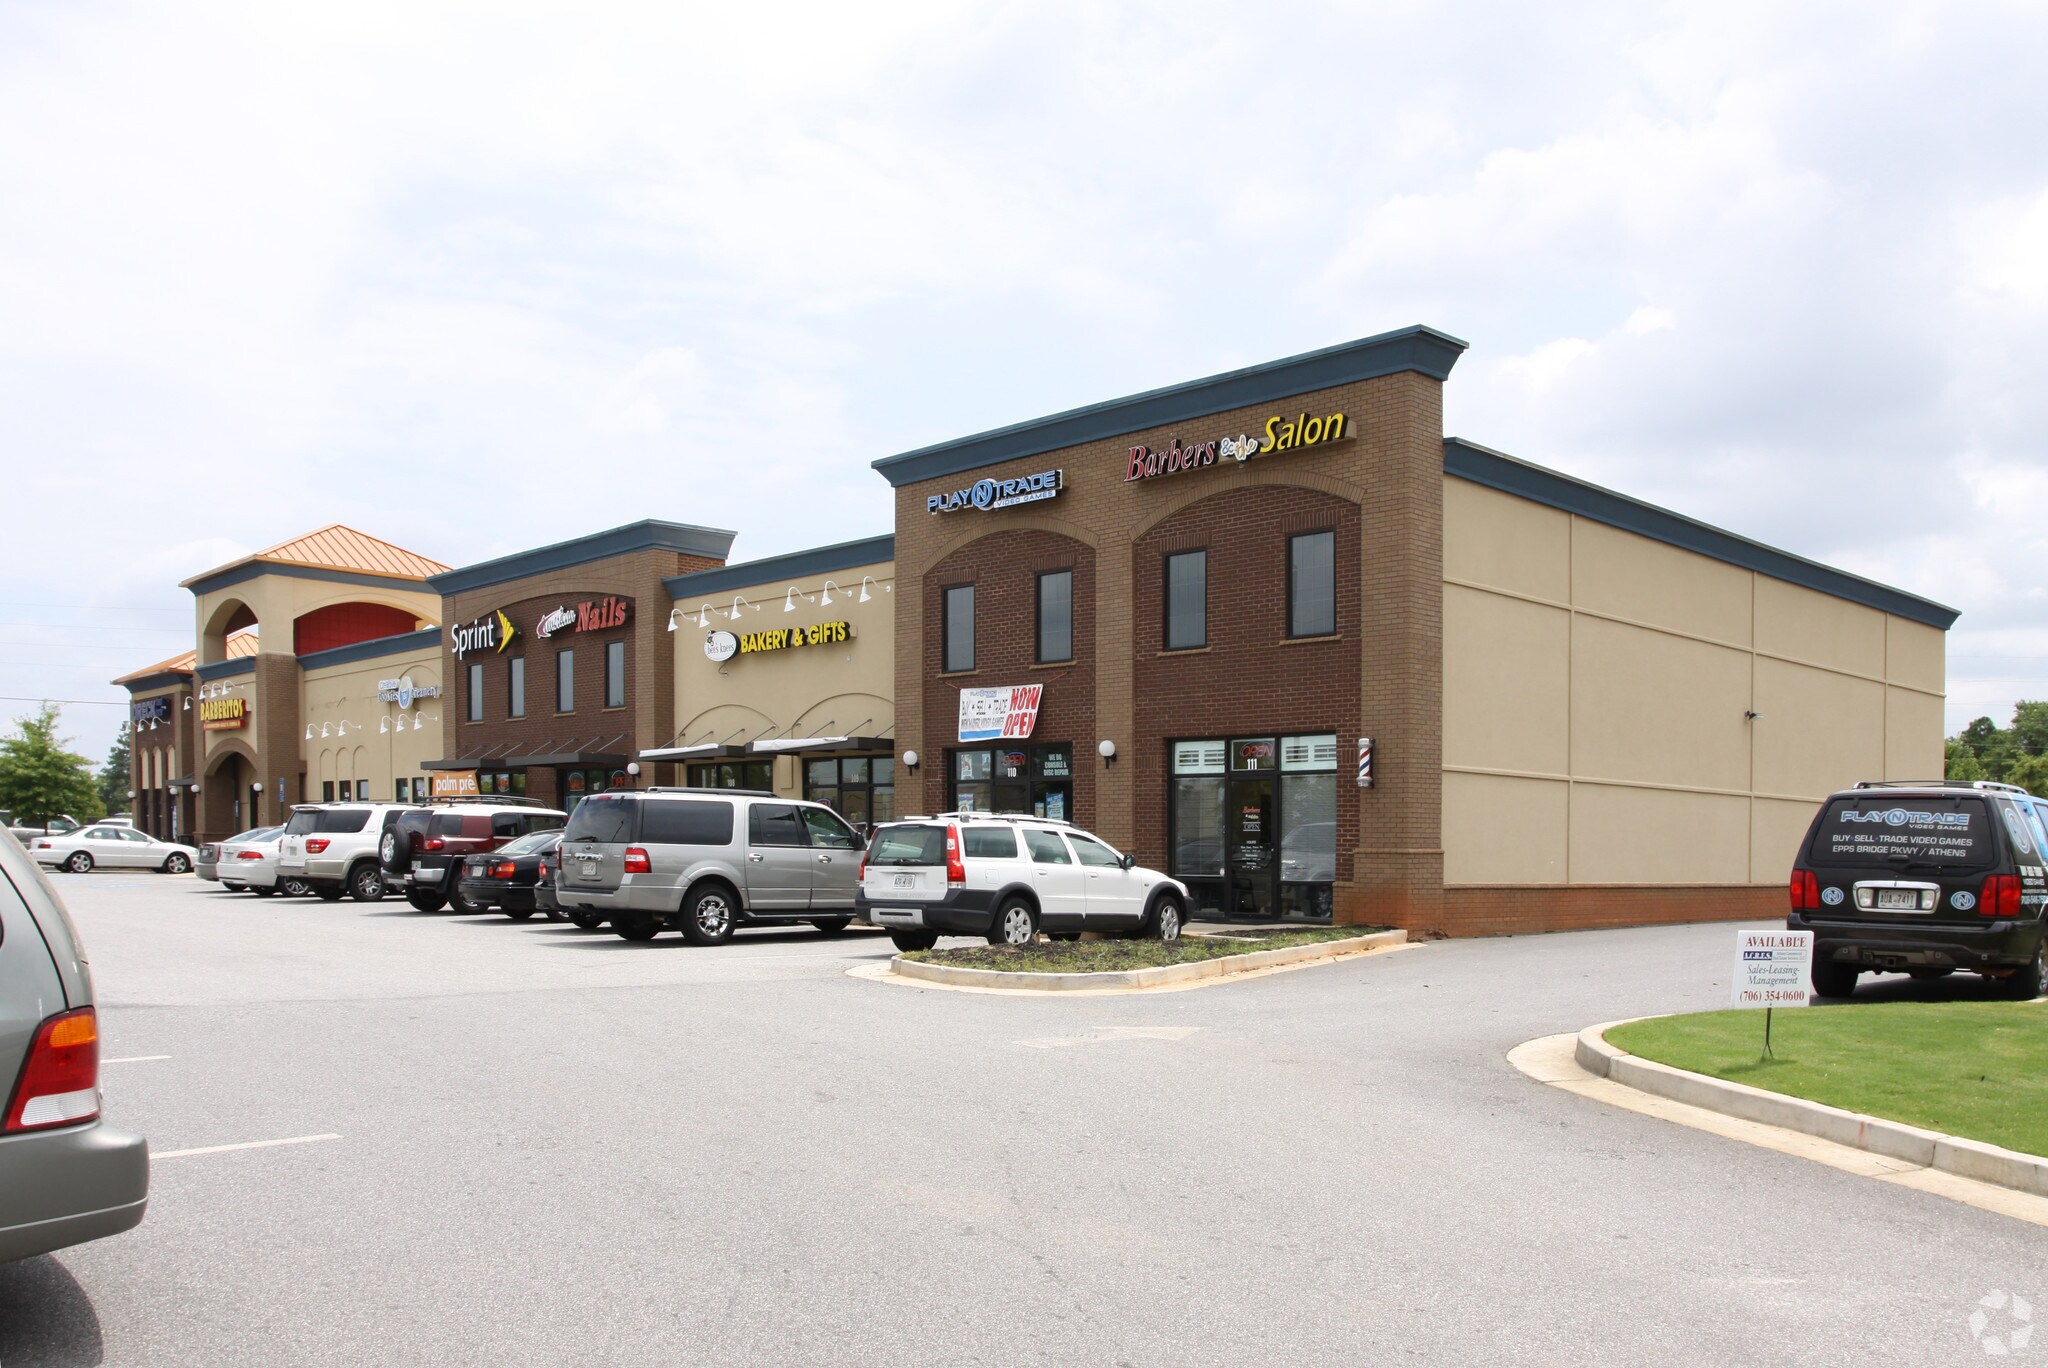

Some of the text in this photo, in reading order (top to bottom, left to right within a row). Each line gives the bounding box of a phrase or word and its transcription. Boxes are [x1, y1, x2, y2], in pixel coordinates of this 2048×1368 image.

[1124, 439, 1215, 482] Barbers
[1260, 412, 1344, 453] Salon
[928, 487, 972, 512] PLAY
[993, 470, 1056, 496] TRADE
[996, 490, 1054, 507] VIDEO GAMES
[575, 596, 627, 633] Nails
[452, 617, 494, 661] Sprint
[740, 621, 846, 653] BAKERY & GIFTS
[1010, 687, 1041, 711] NOW
[200, 699, 244, 721] BARBERITOS
[1003, 712, 1036, 736] OPEN
[1242, 745, 1275, 757] OPEN
[1247, 758, 1257, 770] 111
[1007, 768, 1017, 777] 110
[1055, 768, 1069, 776] REPAIR
[435, 776, 457, 794] palm
[1841, 811, 1886, 822] PLAY
[1907, 812, 1970, 825] TRADE
[1832, 834, 1851, 842] BUY
[1879, 835, 1908, 843] TRADE
[1910, 836, 1937, 845] VIDEO
[1939, 838, 1973, 847] GAMES
[1832, 845, 1855, 853] EPPS
[1856, 845, 1889, 854] BRIDGE
[1890, 846, 1919, 855] PKWY
[1928, 848, 1967, 857] ATHENS
[1746, 936, 1806, 947] AVAILABLE
[1748, 975, 1798, 987] Management
[1740, 990, 1804, 1002] (706) 354-0600
